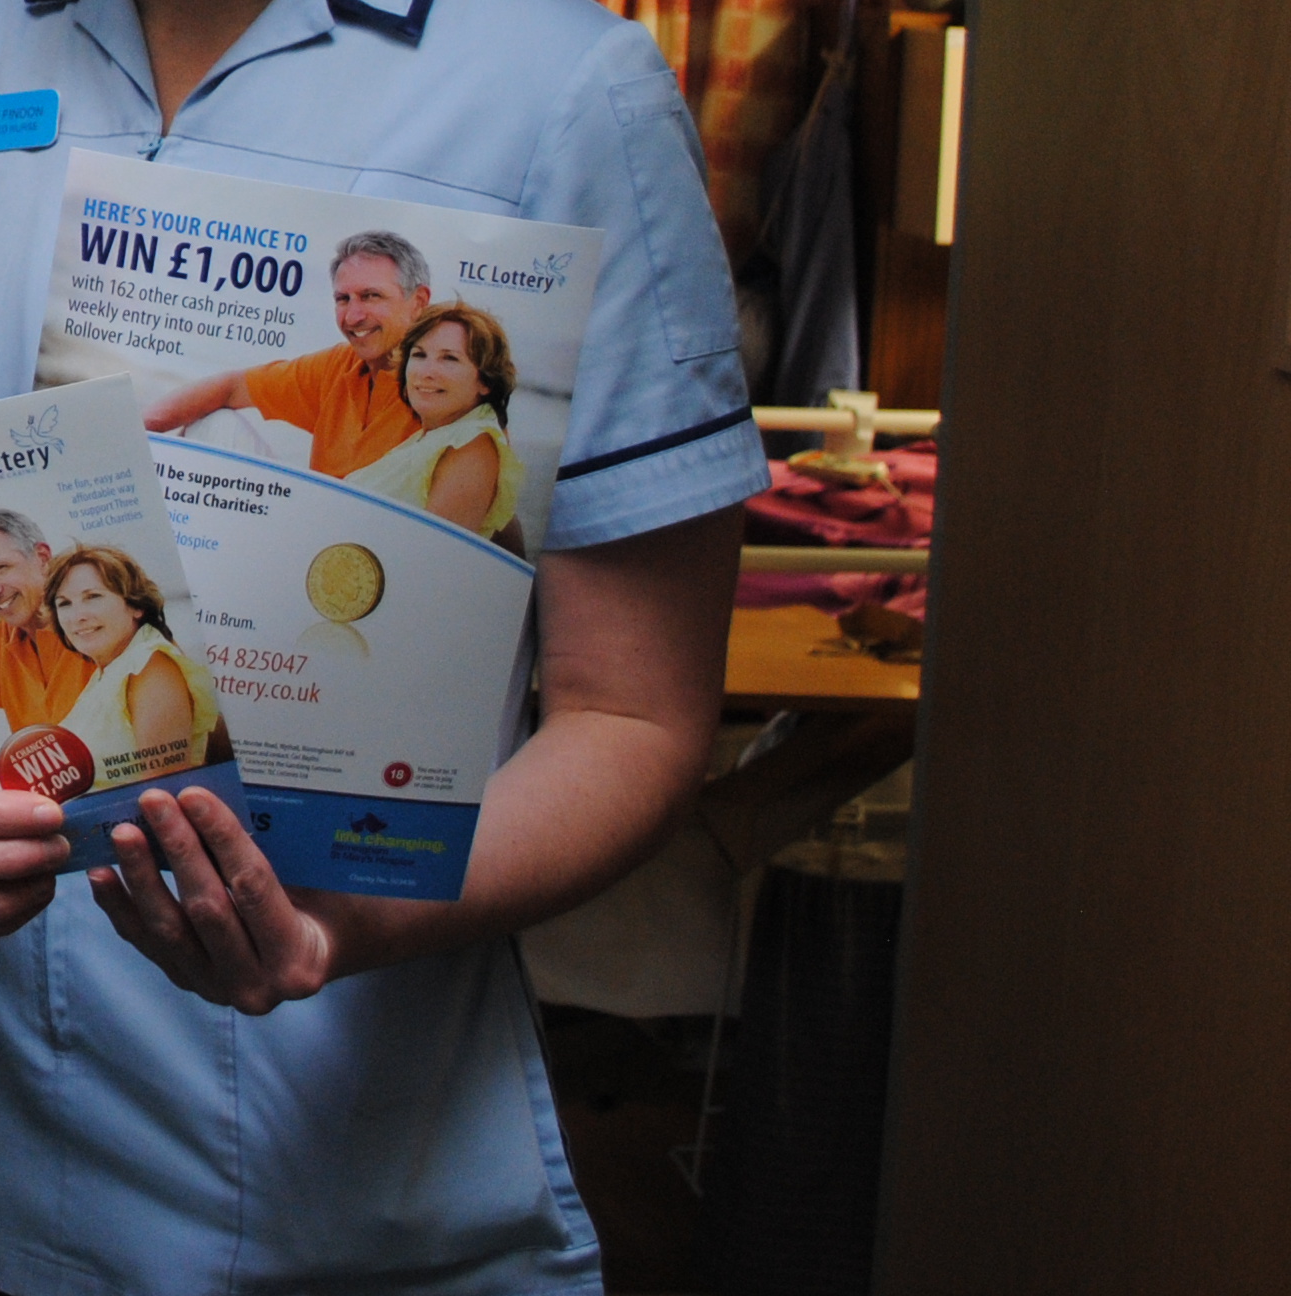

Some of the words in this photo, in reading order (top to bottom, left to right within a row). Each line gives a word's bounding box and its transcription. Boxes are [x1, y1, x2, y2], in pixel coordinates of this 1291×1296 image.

[83, 198, 146, 227] HERE'S
[152, 210, 201, 236] YOUR
[206, 220, 279, 249] CHANCE
[284, 232, 307, 253] TO
[81, 223, 158, 274] WIN
[167, 242, 303, 297] £1,000
[460, 261, 487, 280] TLC
[492, 266, 554, 293] Lottery
[72, 274, 104, 293] with
[110, 279, 135, 299] 162
[139, 286, 178, 306] other
[181, 295, 214, 312] cash
[218, 300, 260, 320] prizes
[264, 307, 295, 325] plus
[65, 318, 122, 344] Rollover
[125, 330, 184, 355] Jackpot.
[69, 298, 119, 323] weekly
[122, 308, 160, 329] entry
[165, 315, 193, 332] into
[197, 321, 222, 337] our
[226, 323, 285, 347] £10,000
[57, 482, 73, 492] The
[93, 474, 113, 486] easy
[115, 470, 132, 480] and
[72, 489, 116, 504] affordable
[118, 483, 135, 497] way
[187, 471, 264, 496] supporting
[69, 510, 79, 519] to
[80, 503, 114, 519] support
[164, 486, 200, 505] Local
[203, 492, 269, 516] Charities:
[81, 519, 104, 531] Local
[234, 648, 308, 674] 825047
[13, 742, 70, 784] WIN
[103, 752, 130, 766] WHAT
[131, 745, 167, 760] WOULD
[168, 739, 188, 751] YOU
[107, 768, 121, 779] DO
[122, 762, 147, 776] WITH
